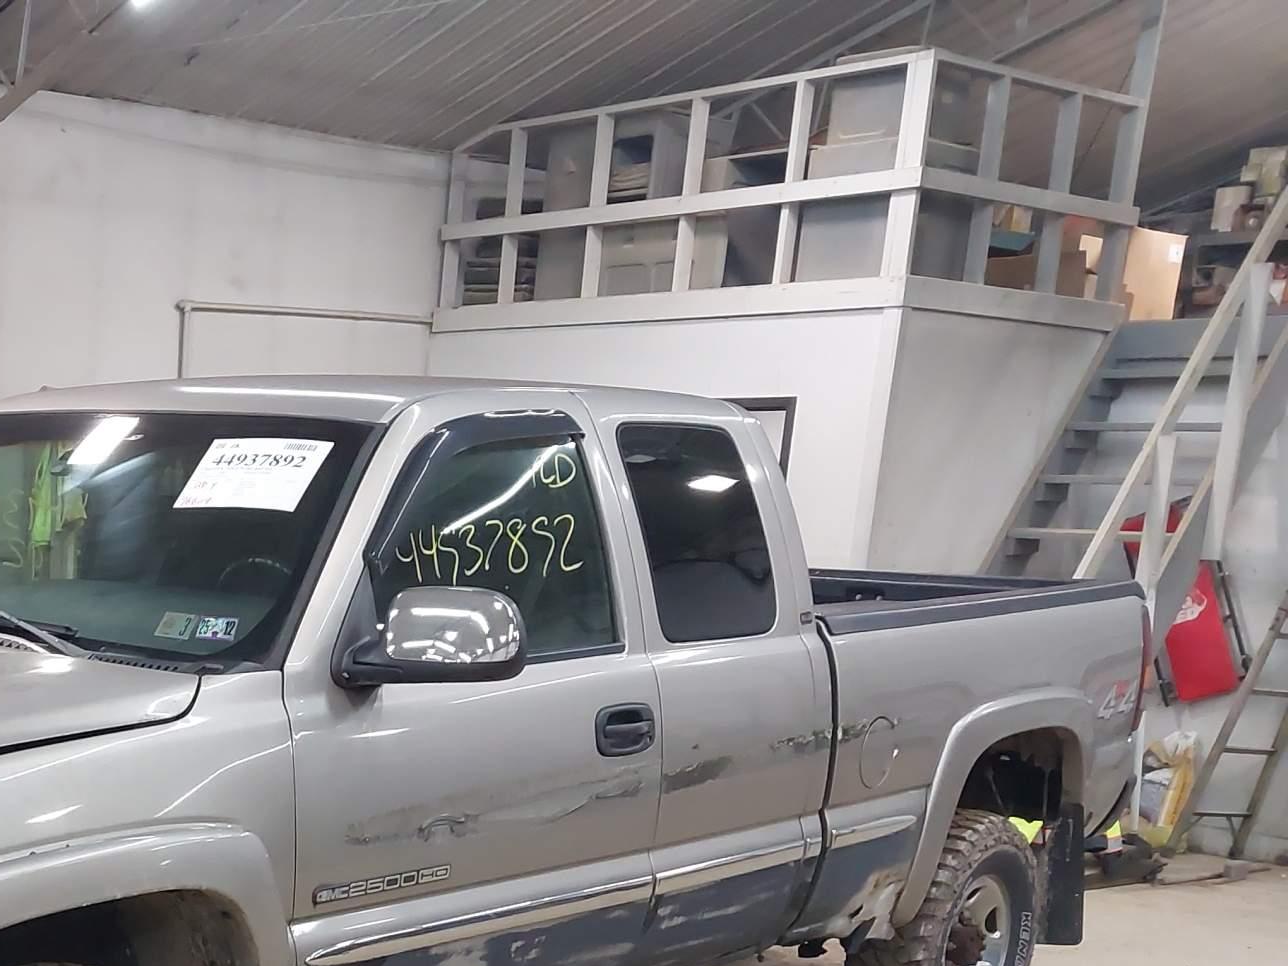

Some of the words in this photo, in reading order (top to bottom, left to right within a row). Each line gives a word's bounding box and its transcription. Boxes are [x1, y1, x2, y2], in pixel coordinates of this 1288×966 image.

[212, 453, 307, 468] 44937892
[198, 619, 210, 635] 25
[223, 620, 236, 636] 12
